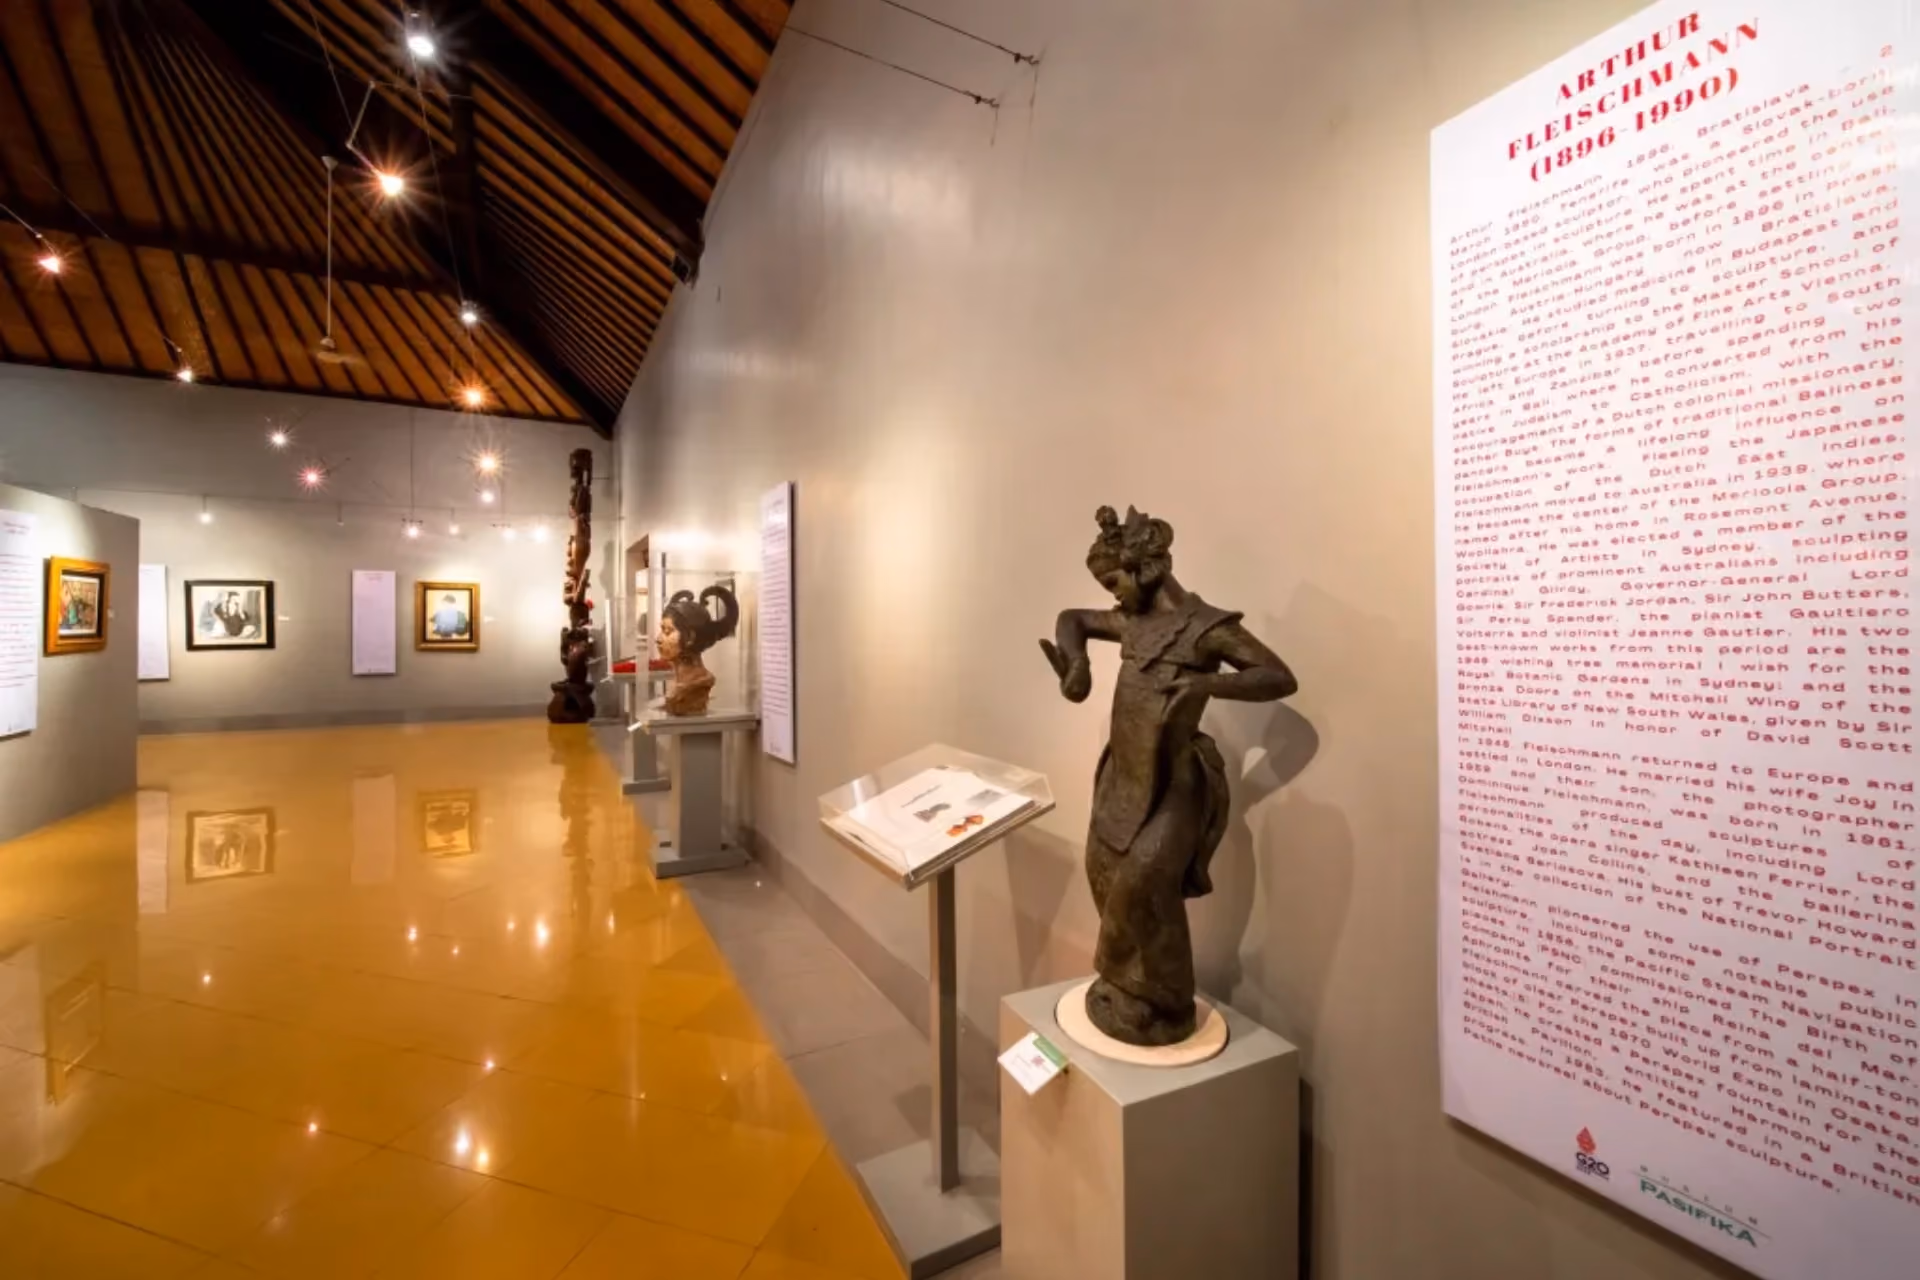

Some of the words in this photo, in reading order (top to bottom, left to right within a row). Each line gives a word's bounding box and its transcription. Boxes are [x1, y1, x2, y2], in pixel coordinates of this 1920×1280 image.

[1556, 12, 1701, 103] ARTHUR
[1507, 17, 1760, 161] FLEISCHMANN
[1696, 83, 1810, 138] Bratislava
[1530, 67, 1740, 183] (1896-1990)
[1638, 175, 1674, 195] who
[1682, 126, 1789, 178] pioneered
[1800, 108, 1839, 129] the
[1851, 84, 1895, 109] use
[1653, 152, 1690, 173] was
[1675, 193, 1713, 212] was
[1760, 161, 1797, 180] the
[1679, 166, 1735, 195] spent
[1747, 144, 1796, 168] time
[1669, 200, 1737, 232] before
[1614, 265, 1696, 297] medicine
[1731, 218, 1838, 261] Budapest
[1852, 197, 1898, 222] and
[1652, 232, 1696, 253] born
[1683, 240, 1722, 258] now
[1586, 296, 1650, 321] turning
[1852, 217, 1899, 241] and
[1652, 302, 1684, 317] the
[1692, 277, 1767, 305] Master
[1779, 249, 1859, 280] School
[1665, 313, 1766, 345] travelling
[1827, 277, 1901, 304] South
[1692, 305, 1734, 322] Fine
[1743, 289, 1791, 308] Arts
[1639, 346, 1705, 368] before
[1727, 315, 1826, 347] spending
[1853, 296, 1902, 315] two
[1664, 345, 1771, 379] converted
[1789, 329, 1847, 349] from
[1866, 316, 1902, 332] his
[1779, 351, 1830, 370] with
[1860, 336, 1903, 352] the
[1612, 404, 1666, 423] Dutch
[1673, 385, 1753, 409] colonial
[1637, 428, 1710, 447] lifelong
[1735, 405, 1842, 430] influence
[1874, 393, 1905, 407] on
[1672, 395, 1787, 426] traditional
[1798, 374, 1903, 402] Balinese
[1641, 445, 1710, 462] Fleeing
[1729, 436, 1764, 449] the
[1786, 413, 1905, 440] Japanese
[1629, 477, 1718, 496] Australia
[1826, 452, 1906, 470] where
[1649, 462, 1706, 478] Dutch
[1737, 449, 1786, 465] East
[1610, 530, 1680, 546] elected
[1717, 520, 1804, 535] member
[1864, 510, 1907, 522] the
[1683, 503, 1789, 521] Rosemont
[1558, 565, 1644, 580] prominent
[1659, 557, 1778, 573] Australians
[1796, 549, 1909, 564] including
[1560, 553, 1619, 564] Artists
[1791, 530, 1908, 548] sculpting
[1704, 593, 1732, 604] Sir
[1741, 592, 1792, 603] John
[1850, 566, 1909, 580] Lord
[1554, 628, 1619, 638] violinist
[1629, 629, 1694, 638] Jeanne
[1811, 626, 1847, 637] His
[1860, 626, 1910, 637] two
[1691, 610, 1763, 622] pianist
[1789, 607, 1910, 620] Gaultiero
[1499, 657, 1554, 668] wishing
[1740, 662, 1789, 672] wish
[1808, 662, 1846, 674] for
[1867, 664, 1910, 676] the
[1718, 644, 1789, 656] period
[1807, 646, 1846, 655] are
[1867, 645, 1910, 656] the
[1649, 691, 1728, 704] Mitchell
[1746, 696, 1800, 711] Wing
[1821, 699, 1846, 711] of
[1868, 702, 1912, 715] the
[1802, 682, 1846, 693] and
[1868, 683, 1911, 695] the
[1583, 703, 1619, 714] New
[1626, 705, 1680, 718] South
[1765, 715, 1827, 728] given
[1877, 720, 1912, 733] Sir
[1624, 721, 1677, 734] honor
[1746, 730, 1810, 745] David
[1838, 737, 1912, 754] Scott
[1523, 741, 1621, 760] Fleischmann
[1631, 755, 1718, 772] returned
[1767, 767, 1850, 786] Europe
[1866, 779, 1914, 793] and
[1638, 771, 1715, 788] married
[1726, 780, 1756, 793] his
[1769, 787, 1819, 801] wife
[1834, 794, 1877, 811] Joy
[1556, 775, 1595, 787] their
[1681, 792, 1714, 805] the
[1743, 801, 1914, 831] photographer
[1669, 808, 1708, 821] was
[1729, 814, 1779, 832] born
[1579, 809, 1663, 830] produced
[1708, 830, 1828, 858] sculptures
[1887, 859, 1915, 871] of
[1604, 844, 1660, 860] singer
[1668, 855, 1758, 880] Kathleen
[1872, 893, 1915, 911] the
[1726, 848, 1826, 877] including
[1856, 871, 1916, 892] Lord
[1533, 873, 1614, 898] collection
[1701, 910, 1793, 940] National
[1808, 935, 1916, 970] Portrait
[1651, 882, 1694, 901] bust
[1732, 900, 1807, 925] Trevor
[1817, 919, 1917, 950] Howard
[1675, 873, 1711, 888] and
[1802, 898, 1916, 931] ballerina
[1547, 905, 1631, 933] pioneered
[1688, 942, 1723, 958] use
[1777, 963, 1875, 998] Perspex
[1600, 964, 1732, 1011] commissioned
[1749, 1007, 1787, 1028] The
[1806, 1025, 1868, 1053] Birth
[1889, 1053, 1918, 1067] of
[1701, 977, 1769, 1005] Steam
[1781, 1000, 1919, 1049] Navigation
[1722, 968, 1808, 999] notable
[1839, 1000, 1918, 1029] public
[1660, 1015, 1712, 1038] piece
[1812, 1063, 1920, 1108] half-ton
[1712, 1013, 1771, 1041] Reina
[1797, 1043, 1832, 1060] del
[1662, 1046, 1721, 1075] World
[1732, 1071, 1784, 1098] Expo
[1639, 1100, 1716, 1140] Perspex
[1657, 1092, 1748, 1136] featured
[1716, 1082, 1811, 1126] fountain
[1876, 1142, 1920, 1167] the
[1792, 1074, 1920, 1128] laminated
[1576, 1152, 1610, 1175] G20
[1731, 1104, 1832, 1154] Harmony
[1872, 1161, 1920, 1187] and
[1640, 1179, 1757, 1248] PASIFIKA
